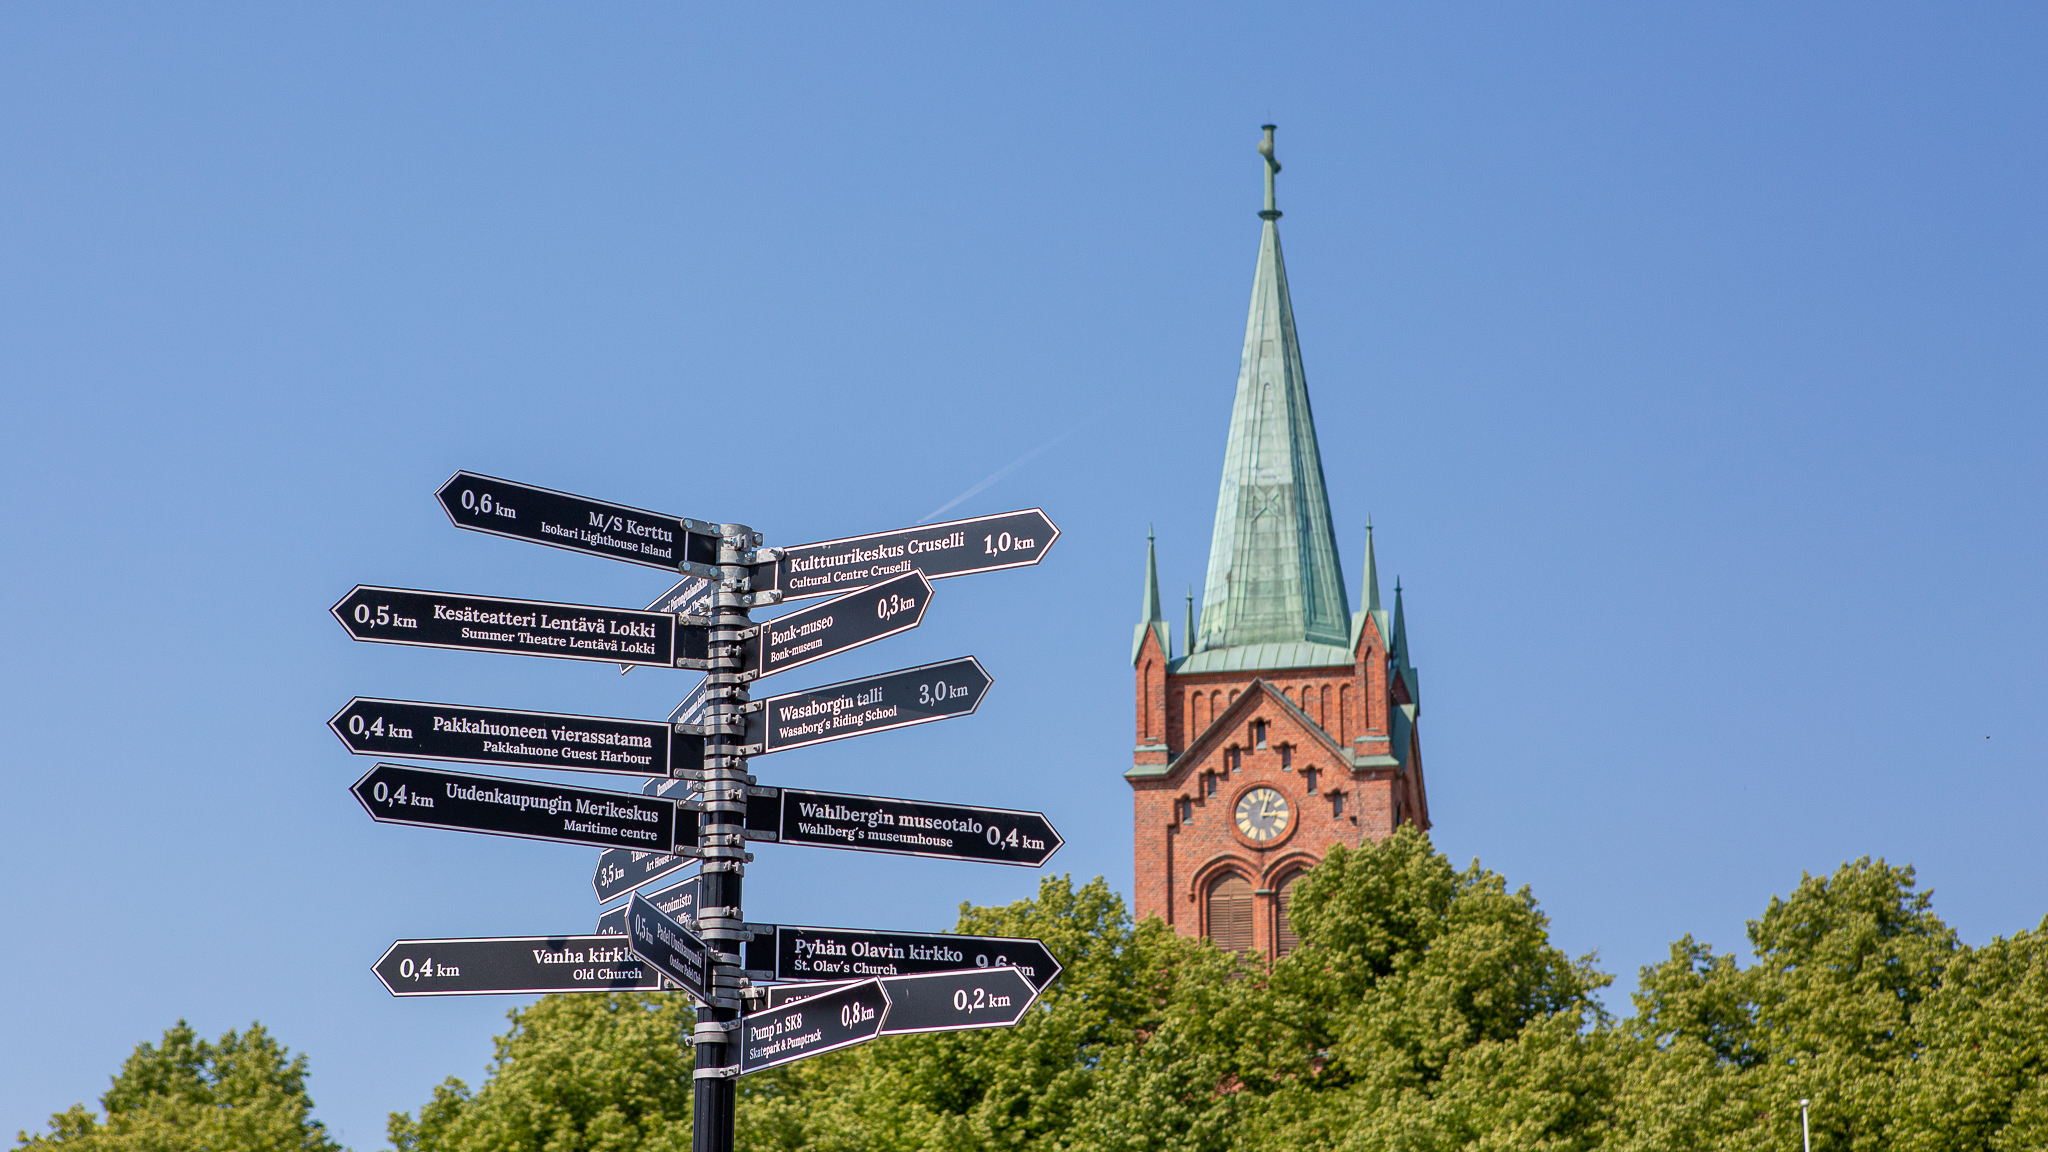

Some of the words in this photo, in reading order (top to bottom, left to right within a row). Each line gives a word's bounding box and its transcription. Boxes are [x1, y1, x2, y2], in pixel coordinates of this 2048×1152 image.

[461, 489, 493, 516] 0,6
[495, 502, 517, 519] km
[541, 521, 578, 539] Isokari
[580, 528, 638, 552] Lighthouse
[641, 542, 672, 559] Island
[589, 511, 623, 532] M/S
[626, 518, 673, 543] Kerttu
[790, 545, 904, 573] Kulttuurikeskus
[907, 532, 965, 555] Cruselli
[983, 532, 1012, 557] 1,0
[1013, 537, 1035, 552] km
[789, 572, 832, 589] Cultural
[833, 568, 869, 583] Centre
[870, 560, 911, 579] Cruselli
[354, 604, 389, 628] 0,5
[392, 614, 417, 629] km
[877, 594, 899, 621] 0,3
[900, 596, 915, 613] km
[434, 604, 537, 628] Kesäteatteri
[541, 614, 605, 633] Lentävä
[610, 620, 656, 638] Lokki
[771, 615, 834, 647] Bonk-museo
[462, 627, 515, 643] Summer
[518, 631, 567, 647] Theatre
[569, 636, 618, 652] Lentävä
[621, 641, 655, 655] Lokki
[770, 637, 823, 663] Bonk-museum
[779, 694, 854, 722] Wasaborgin
[856, 686, 883, 706] talli
[919, 680, 947, 707] 3,0
[949, 684, 969, 699] km
[349, 715, 384, 739] 0,4
[388, 724, 413, 739] km
[832, 712, 864, 730] Riding
[865, 705, 898, 723] School
[433, 716, 548, 740] Pakkahuoneen
[551, 728, 652, 748] vierassatama
[483, 741, 559, 757] Pakkahuone
[562, 747, 598, 761] Guest
[601, 750, 652, 765] Harbour
[373, 782, 407, 808] 0,4
[411, 793, 434, 808] km
[446, 783, 572, 815] Uudenkaupungin
[576, 799, 659, 823] Merikeskus
[564, 819, 618, 836] Maritime
[620, 827, 658, 841] centre
[799, 802, 895, 828] Wahlbergin
[898, 813, 983, 834] museotalo
[867, 830, 953, 848] museumhouse
[986, 826, 1019, 851] 0,4
[1022, 835, 1045, 850] km
[601, 862, 615, 888] 3,5
[615, 867, 625, 881] km
[645, 861, 655, 873] Art
[654, 855, 670, 868] House
[635, 914, 646, 941] 0,5
[646, 927, 654, 945] km
[657, 922, 670, 946] Padel
[533, 949, 585, 964] Vanha
[795, 939, 847, 959] Pyhän
[851, 941, 905, 959] Olavin
[909, 947, 963, 962] kirkko
[400, 958, 433, 982] 0,4
[437, 963, 460, 977] km
[573, 968, 595, 980] Old
[597, 967, 643, 980] Church
[794, 959, 811, 971] St.
[853, 962, 898, 975] Church
[953, 987, 985, 1014] 0,2
[988, 993, 1011, 1008] km
[784, 1012, 803, 1032] SK8
[841, 1001, 860, 1030] 0,8
[860, 1007, 875, 1022] km
[749, 1042, 780, 1060] Skatepark
[780, 1040, 787, 1051] &
[786, 1028, 822, 1050] Pumptrack
